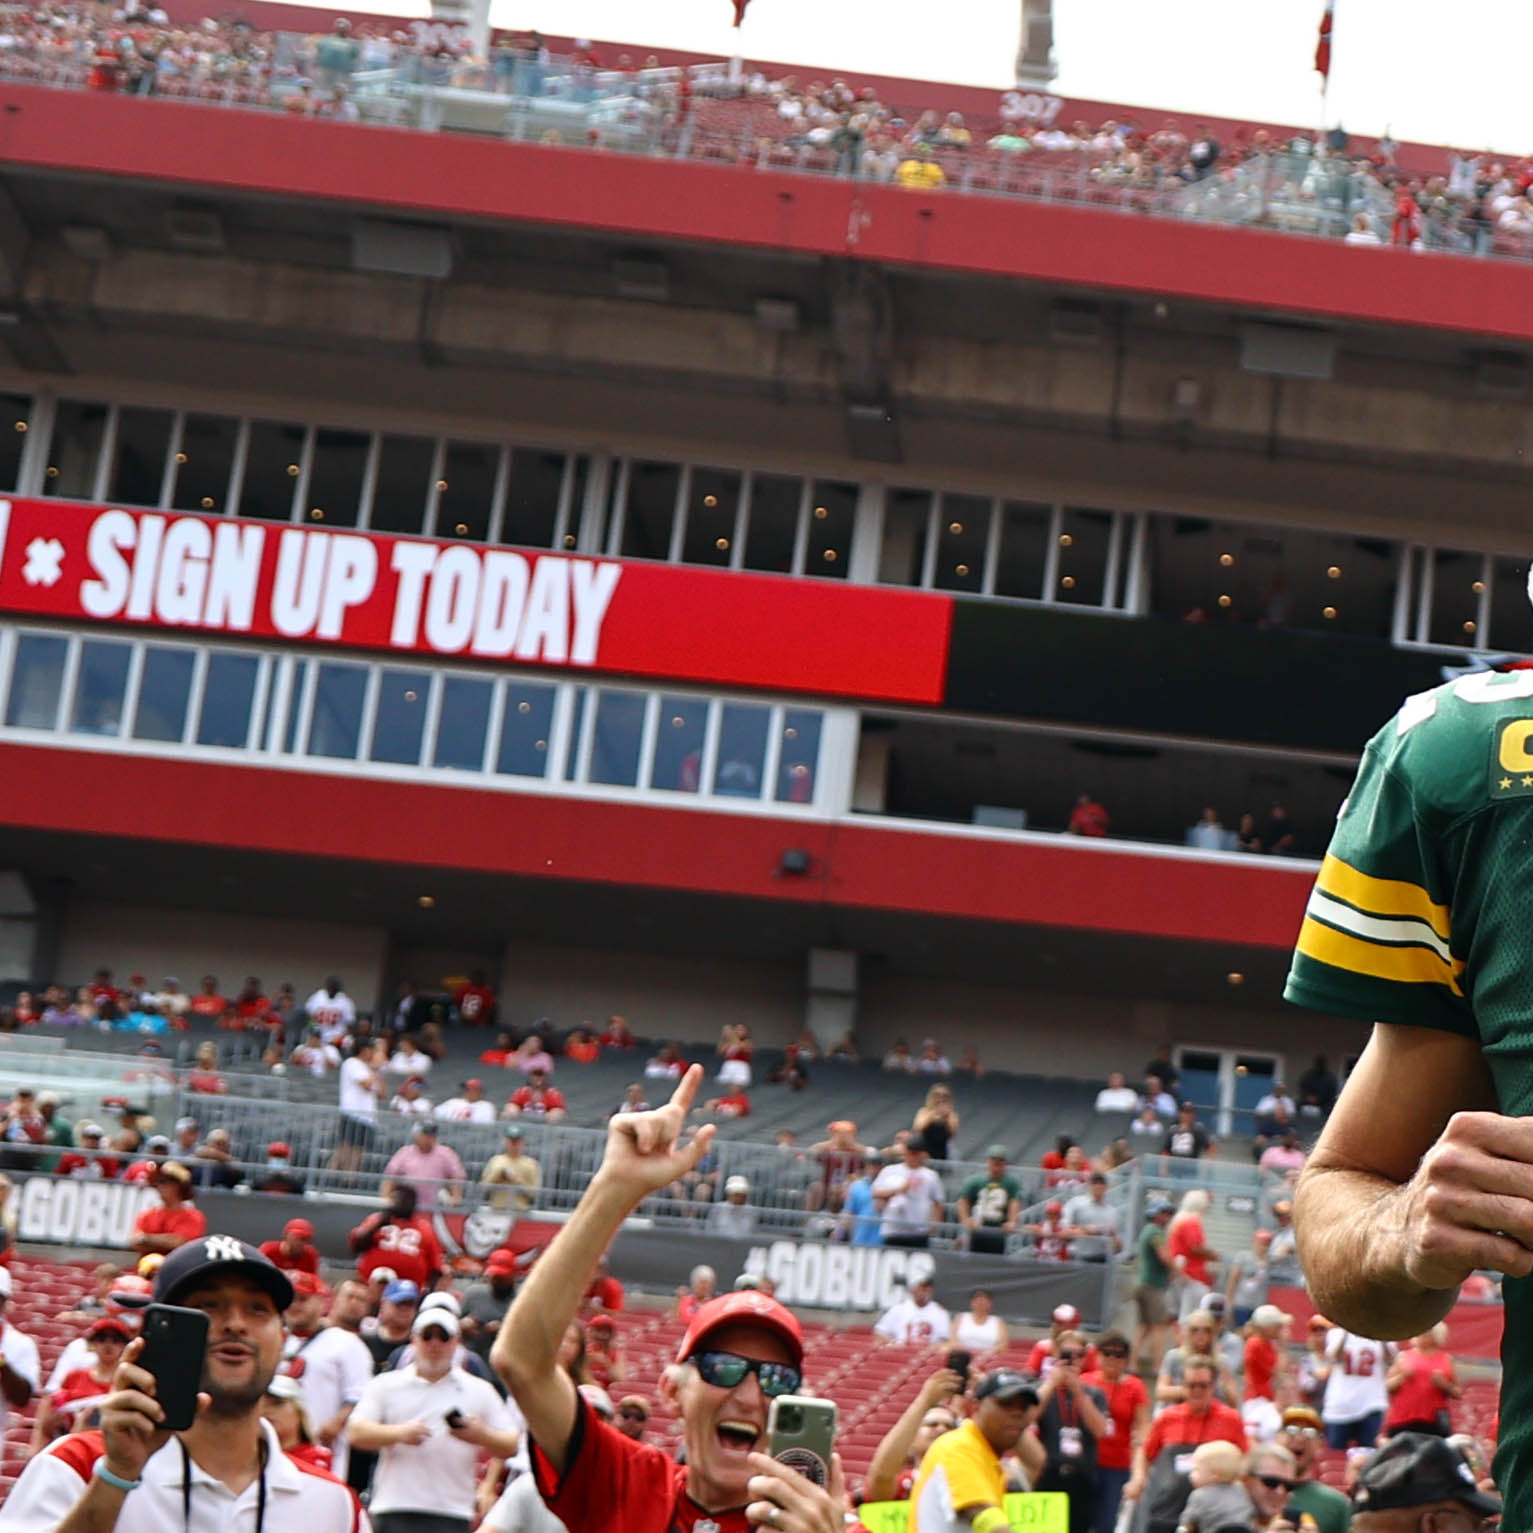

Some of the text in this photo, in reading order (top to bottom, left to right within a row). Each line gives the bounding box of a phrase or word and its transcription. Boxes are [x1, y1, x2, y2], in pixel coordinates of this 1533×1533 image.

[82, 510, 622, 665] SIGN UP TODAY
[1344, 1348, 1376, 1377] 12
